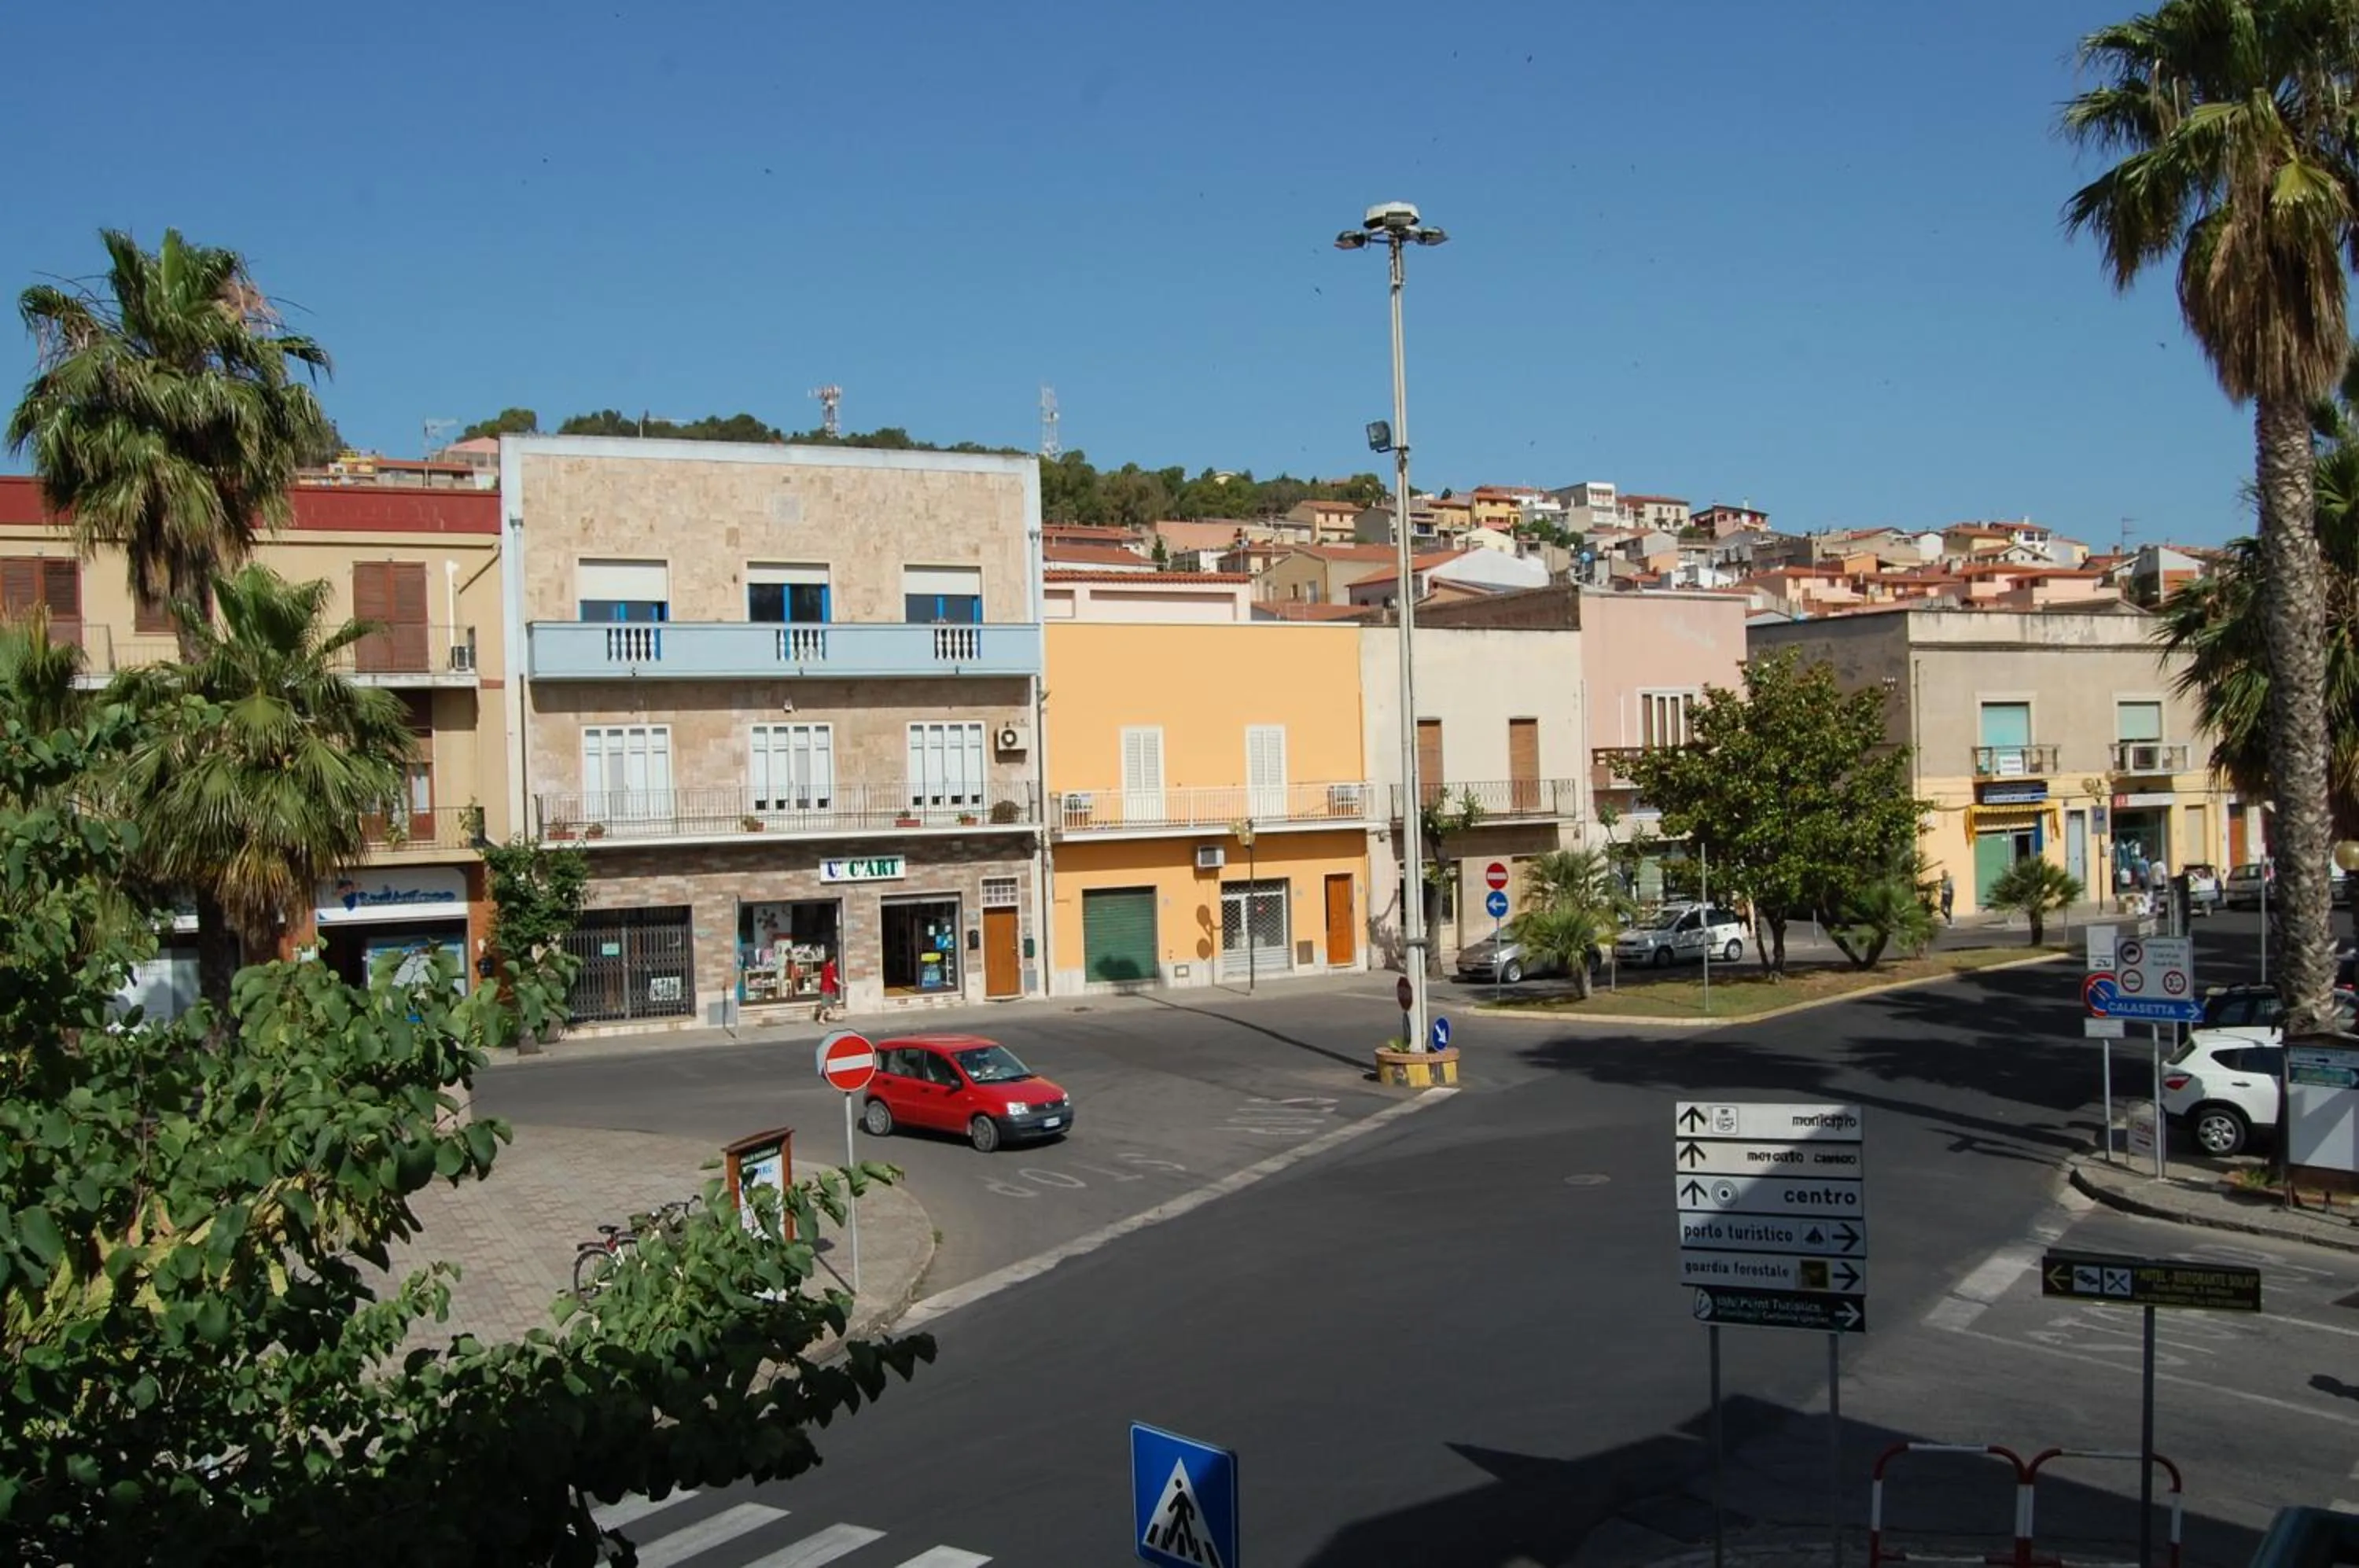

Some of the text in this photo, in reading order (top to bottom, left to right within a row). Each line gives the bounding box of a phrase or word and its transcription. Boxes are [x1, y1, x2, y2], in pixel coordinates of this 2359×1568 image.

[2108, 1002, 2176, 1015] CALASETTA
[1747, 1150, 1804, 1163] mercato
[1784, 1188, 1857, 1205] centro
[1684, 1224, 1793, 1242] porto turistico
[1686, 1260, 1789, 1278] guardia forestale
